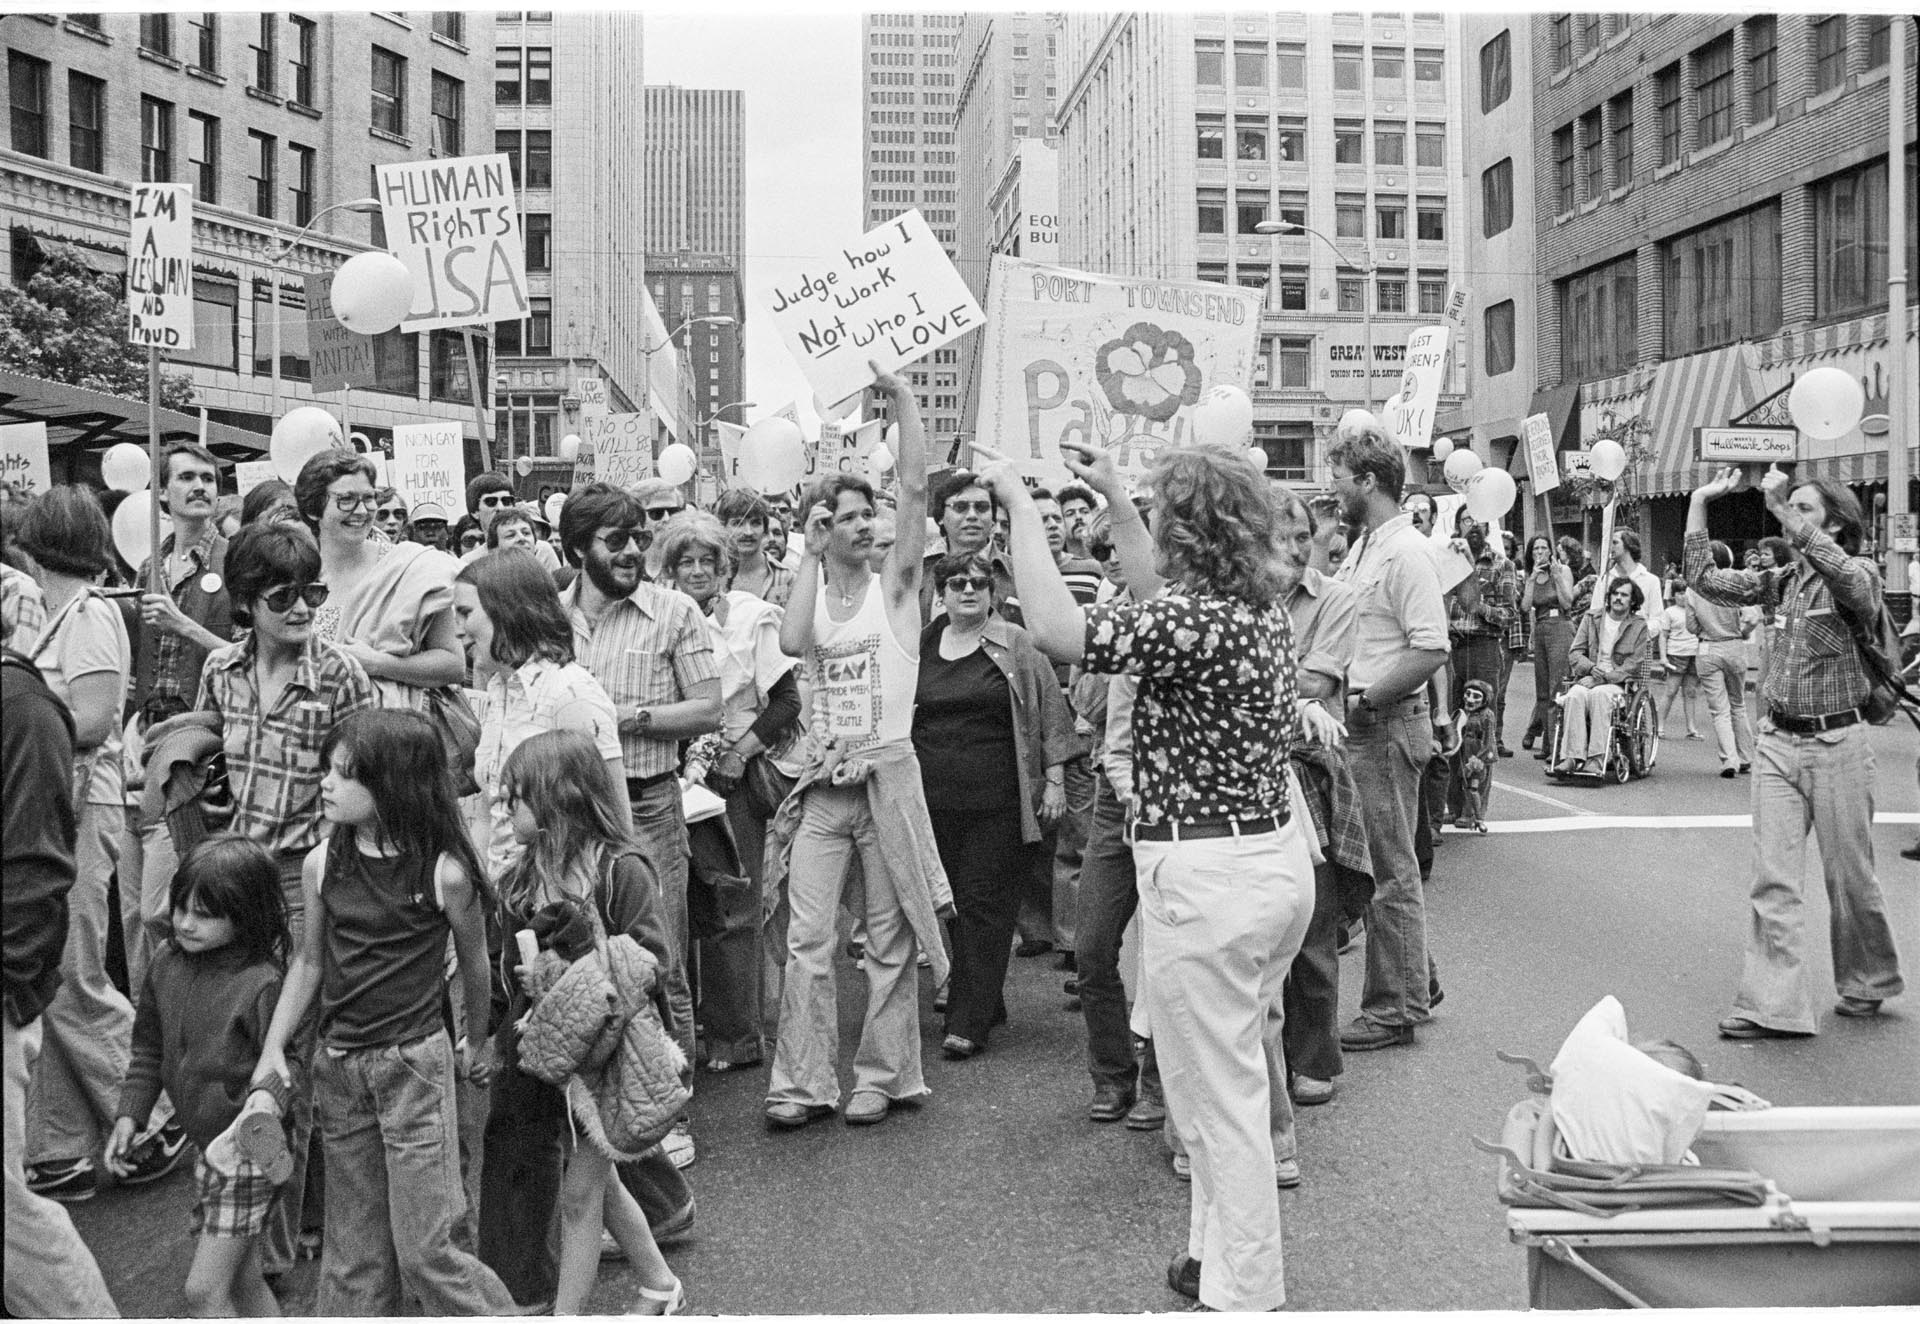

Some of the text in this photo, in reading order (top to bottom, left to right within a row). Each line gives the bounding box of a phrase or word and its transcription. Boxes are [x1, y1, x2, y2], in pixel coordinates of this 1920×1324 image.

[384, 163, 505, 207] HUMAN
[134, 188, 177, 222] I'M
[142, 225, 159, 259] A
[772, 221, 912, 313] Judge how I
[309, 297, 336, 321] HE
[1032, 273, 1246, 326] PORT TOWNSEND
[798, 292, 925, 354] Not who I
[891, 304, 971, 356] LOVE
[313, 342, 370, 377] ANITA!
[1330, 345, 1407, 361] GREA WEST
[1409, 353, 1441, 369] REN?
[1330, 369, 1351, 378] UNION
[1353, 369, 1381, 378] FEDAL
[405, 431, 457, 450] NON-GAY
[596, 437, 632, 455] WILL
[1710, 435, 1792, 453] Hallmark Shops
[416, 453, 438, 469] FOR
[405, 471, 450, 489] HUMAN
[828, 660, 867, 681] GAY
[837, 716, 862, 727] SEATTLE
